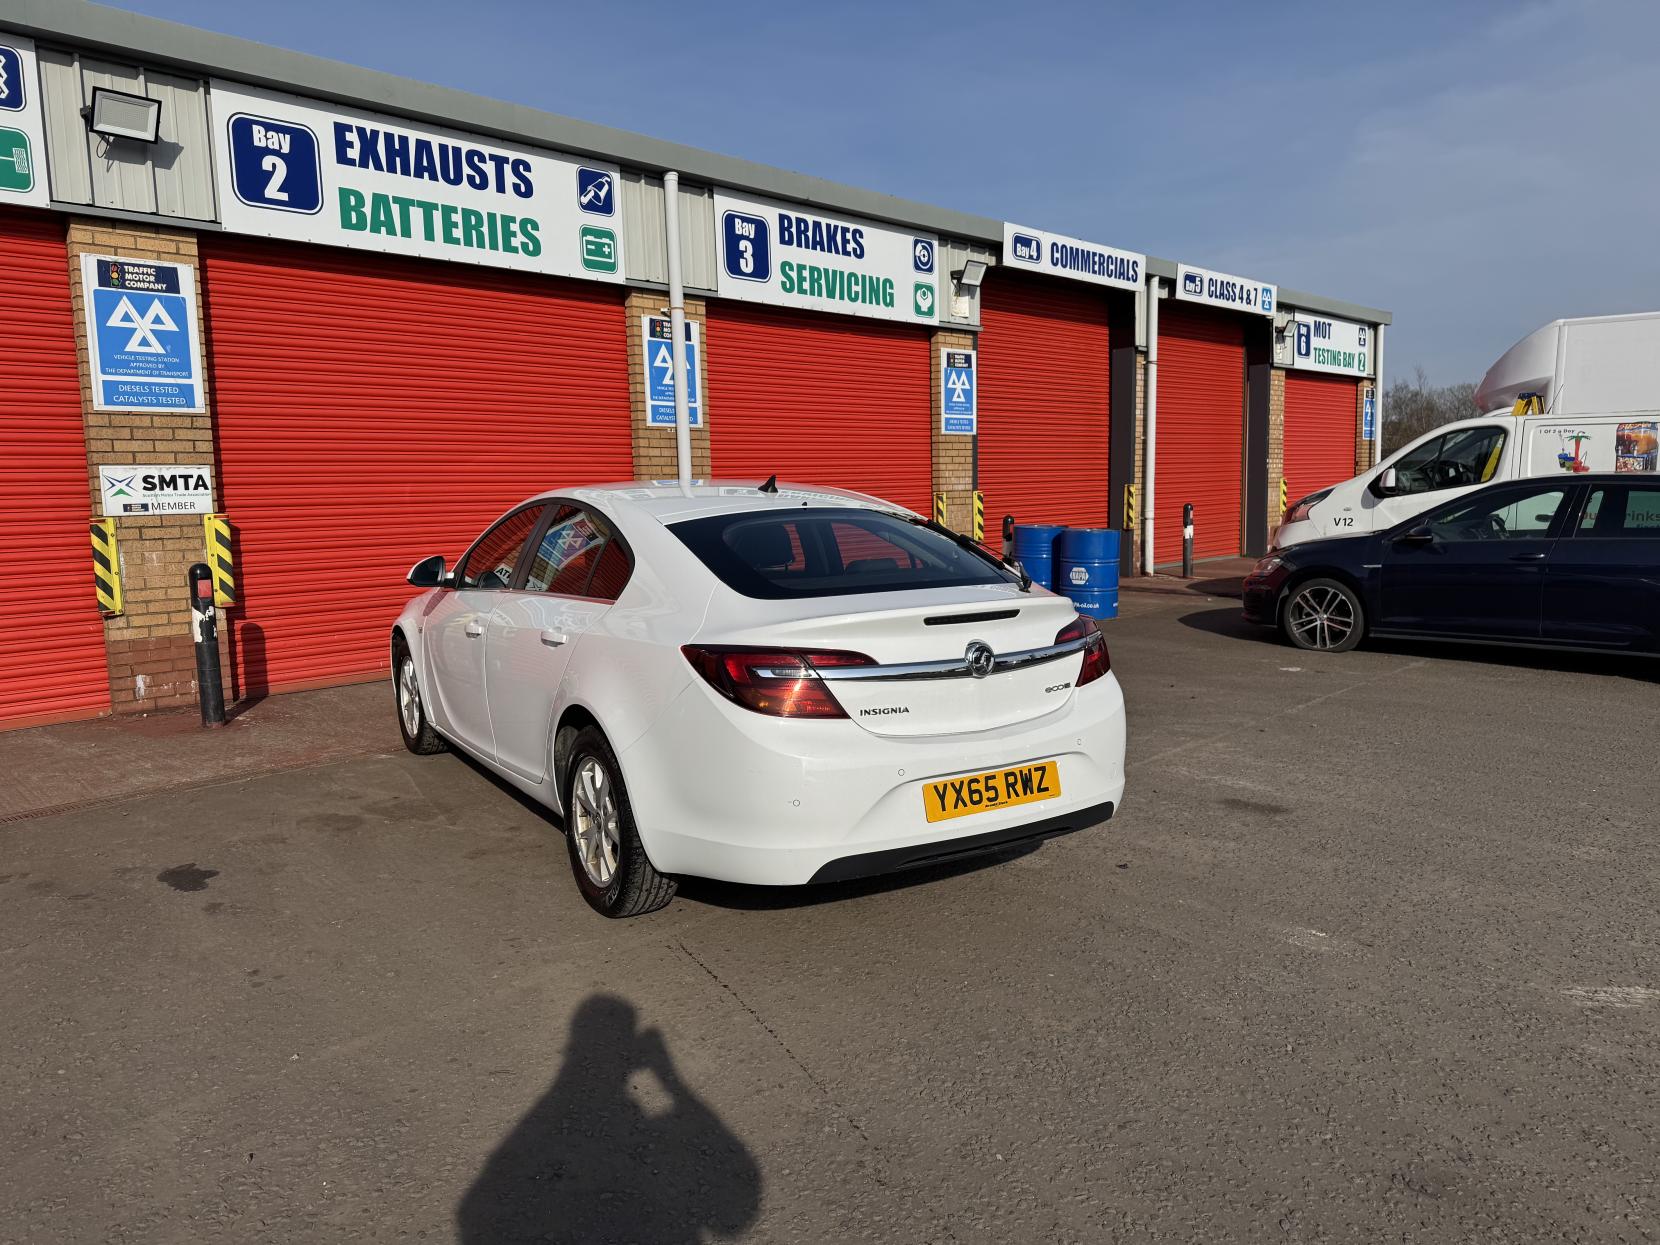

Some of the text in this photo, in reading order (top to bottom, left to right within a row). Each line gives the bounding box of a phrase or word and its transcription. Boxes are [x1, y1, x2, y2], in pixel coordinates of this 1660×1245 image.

[252, 124, 291, 153] Bay
[333, 121, 534, 198] EXHAUSTS
[261, 155, 289, 202] 2
[338, 186, 542, 257] BATTERIES
[735, 218, 755, 239] Bay
[778, 213, 864, 259] BRAKES
[738, 239, 754, 274] 3
[1016, 240, 1038, 259] Bay 4
[123, 265, 156, 274] TRAFFIC
[1050, 241, 1139, 283] COMMERCIALS
[125, 273, 156, 282] MOTOR
[125, 281, 167, 290] COMPANY
[780, 261, 895, 308] SERVICING
[1195, 277, 1201, 293] 5
[1208, 277, 1258, 306] CLASS 4 & 7
[1313, 320, 1332, 340] MOT
[1300, 335, 1307, 355] 6
[1313, 347, 1365, 370] TESTING BAY 2
[118, 384, 179, 394] DIESELS TESTED
[113, 395, 186, 405] CATALYSTS TESTED
[141, 474, 210, 491] SMTA
[151, 501, 196, 511] MEMBER
[859, 706, 910, 717] INSIGNIA
[933, 765, 1050, 812] YX65 RWZ
